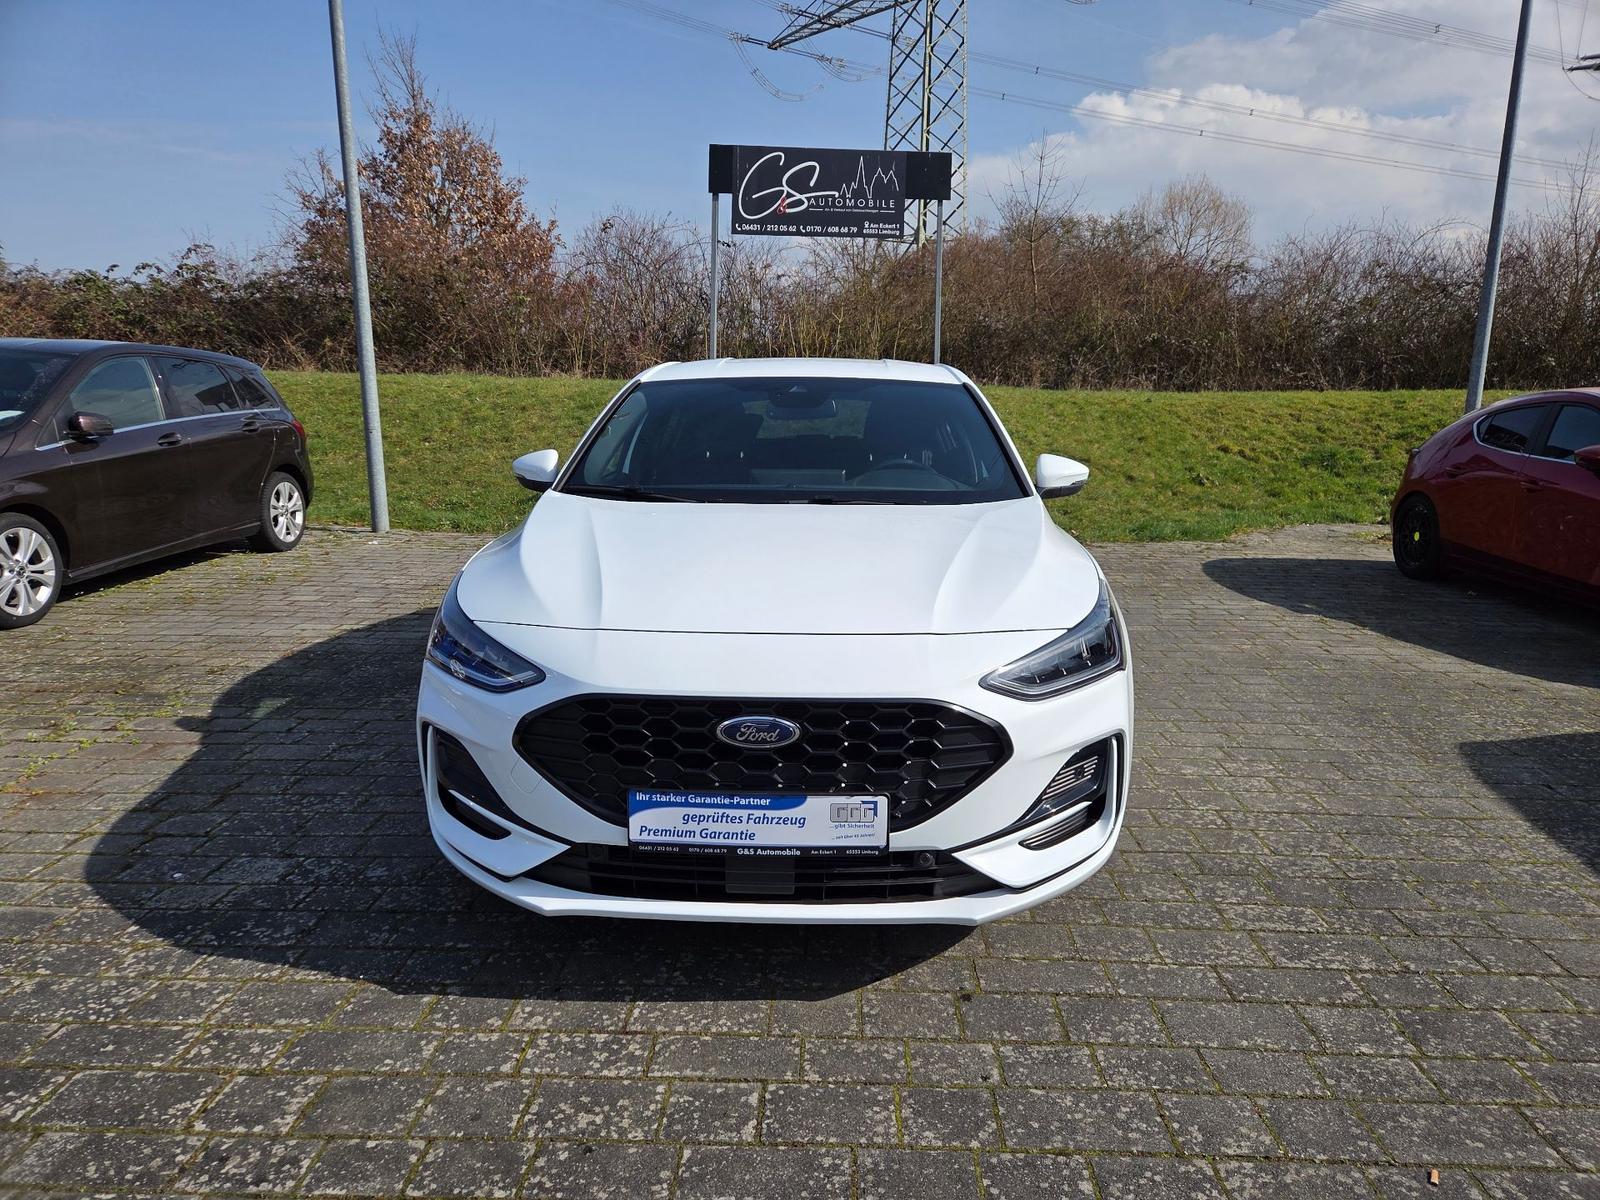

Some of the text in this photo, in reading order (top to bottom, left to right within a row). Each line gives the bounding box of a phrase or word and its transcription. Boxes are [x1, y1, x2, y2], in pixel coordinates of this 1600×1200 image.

[809, 198, 895, 208] AUTOMOBILE
[736, 723, 780, 741] Ford
[636, 792, 771, 806] Ihr starker Garantie-Partner
[682, 812, 806, 828] geprüftes Fahrzeug
[639, 826, 756, 840] Premium Garantie
